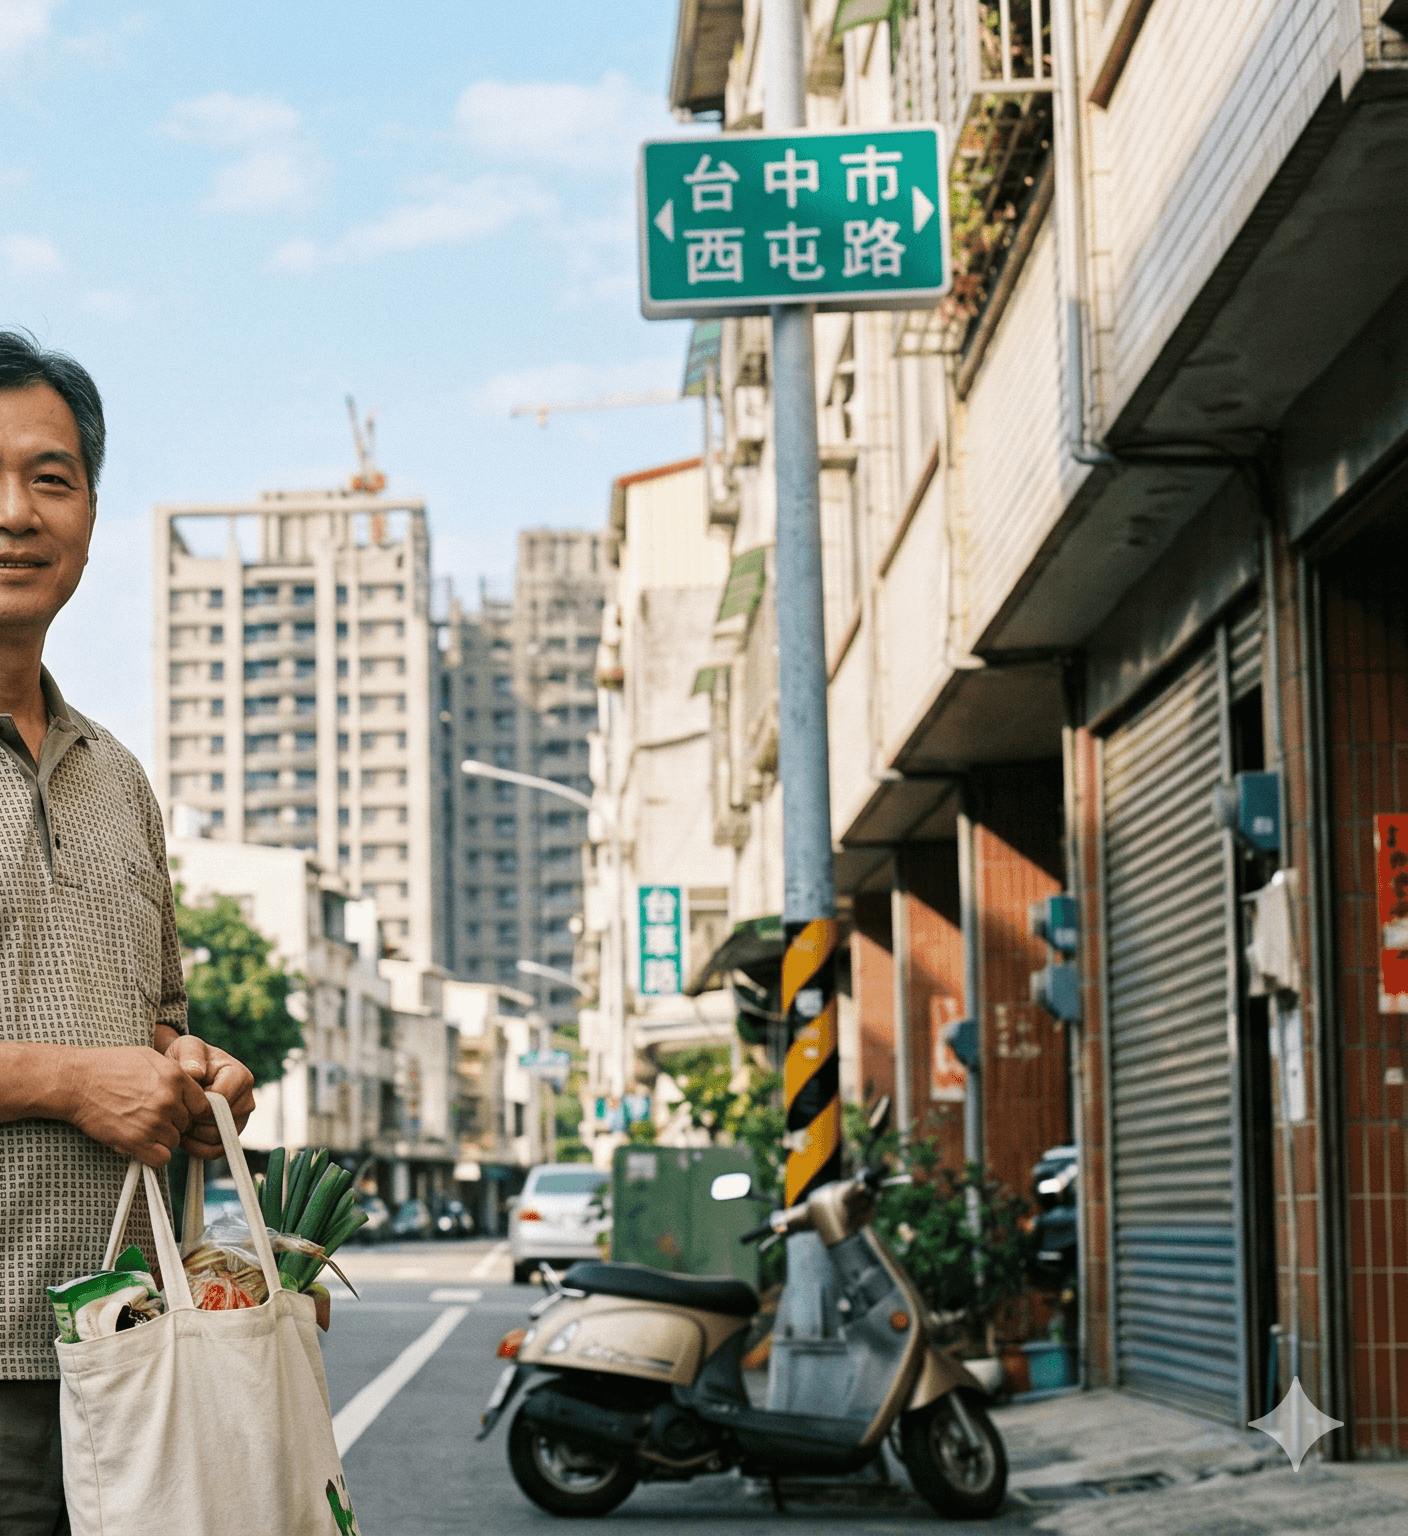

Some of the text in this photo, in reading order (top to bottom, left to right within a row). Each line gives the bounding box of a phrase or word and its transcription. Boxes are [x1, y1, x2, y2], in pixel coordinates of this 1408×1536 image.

[683, 144, 903, 213] 台中市
[682, 217, 906, 285] 西屯路
